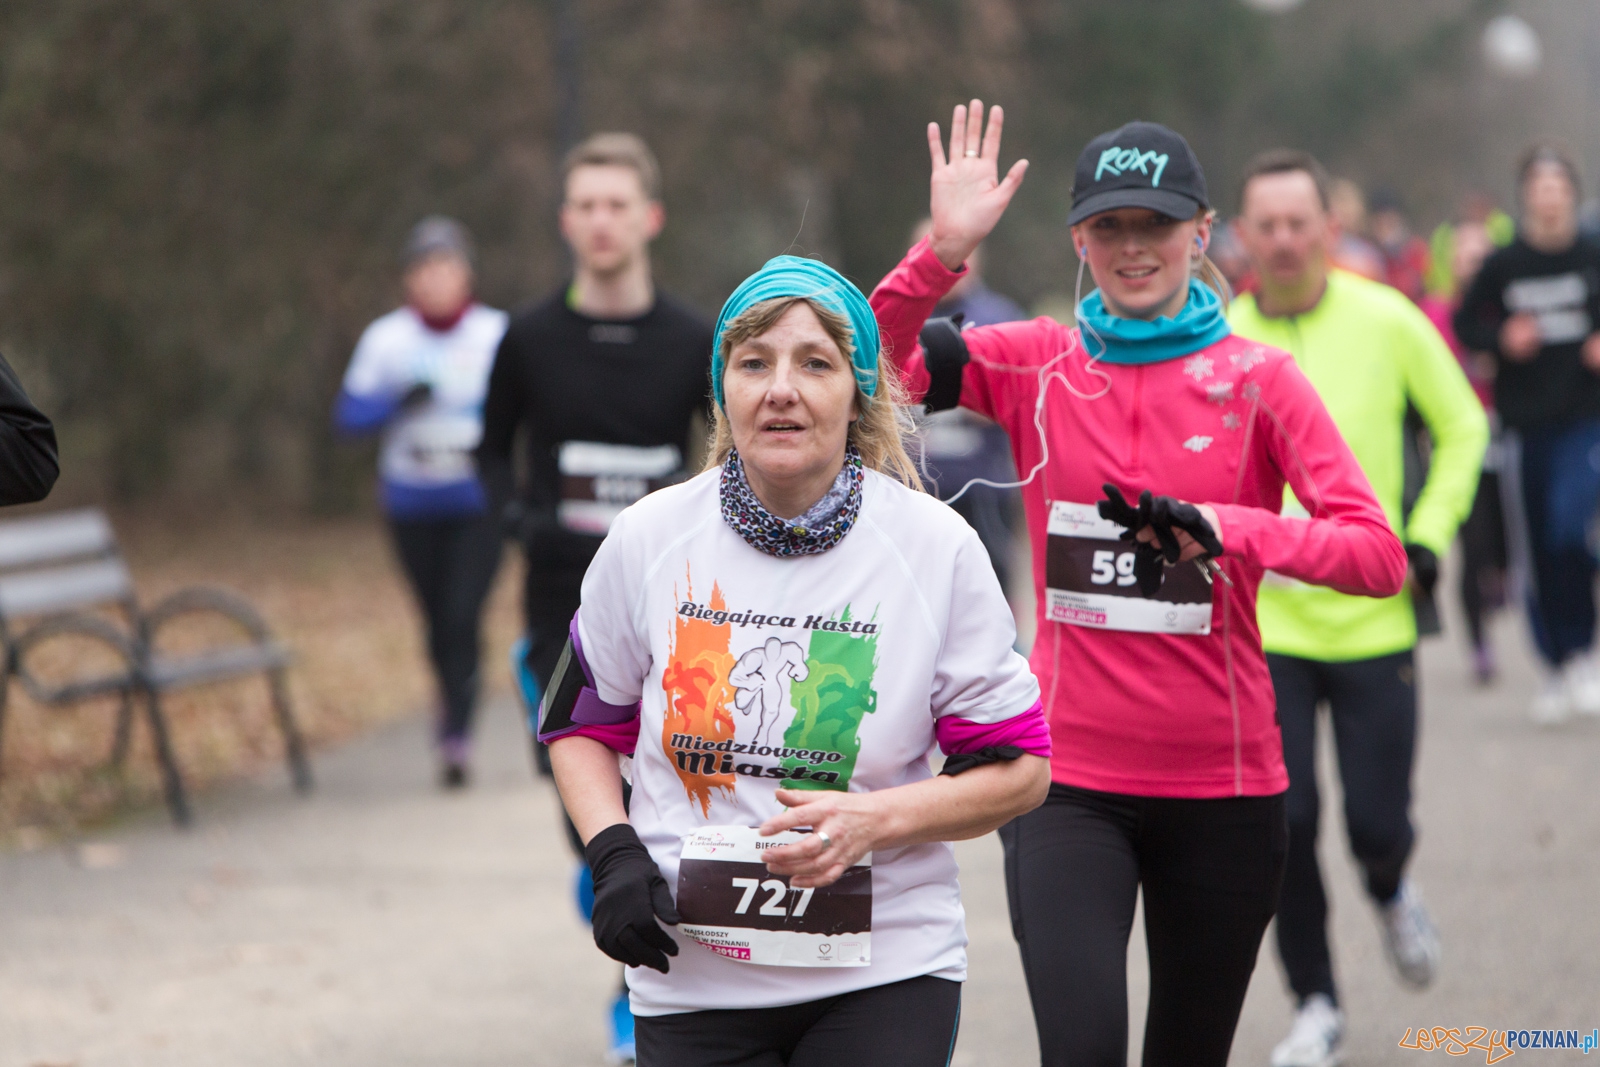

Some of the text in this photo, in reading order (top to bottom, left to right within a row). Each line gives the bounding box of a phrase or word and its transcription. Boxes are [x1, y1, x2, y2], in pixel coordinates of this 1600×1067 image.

[1094, 146, 1169, 188] ROXY
[678, 601, 879, 635] Biegająca Kasta
[670, 733, 846, 765] Miedziowego
[674, 750, 843, 785] Miasta
[732, 877, 816, 917] 727
